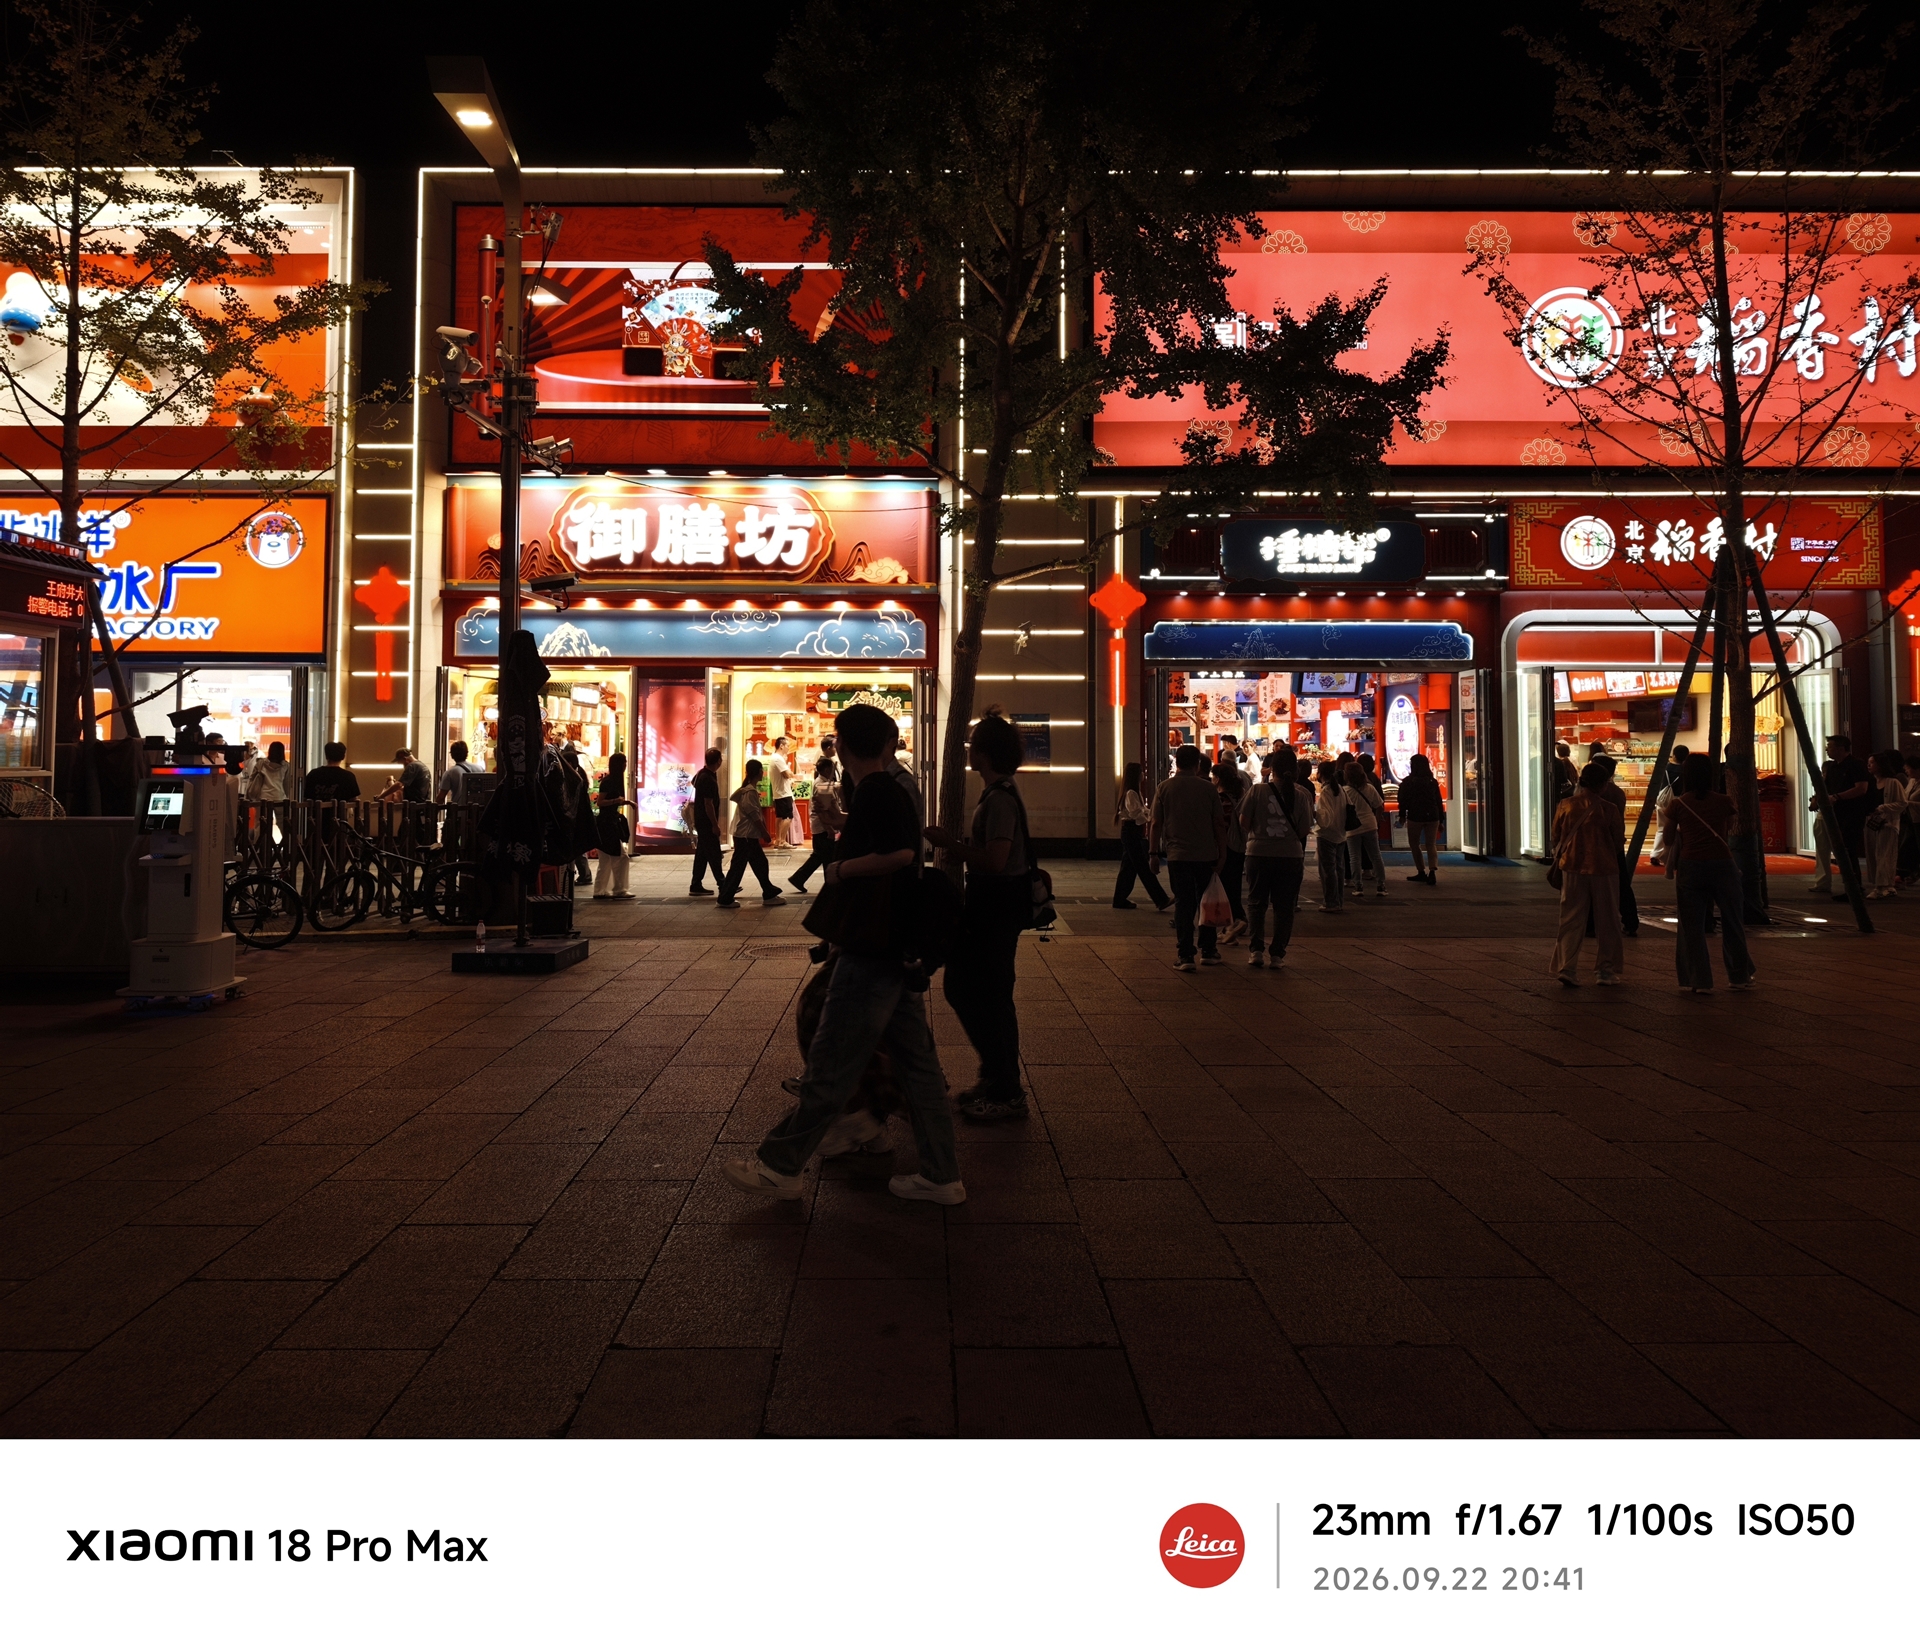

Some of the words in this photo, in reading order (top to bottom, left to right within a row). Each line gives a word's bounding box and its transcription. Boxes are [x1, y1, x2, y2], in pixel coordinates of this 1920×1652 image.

[567, 502, 815, 565] 御膳坊
[1625, 520, 1645, 563] 北京
[104, 620, 216, 636] ACTORY
